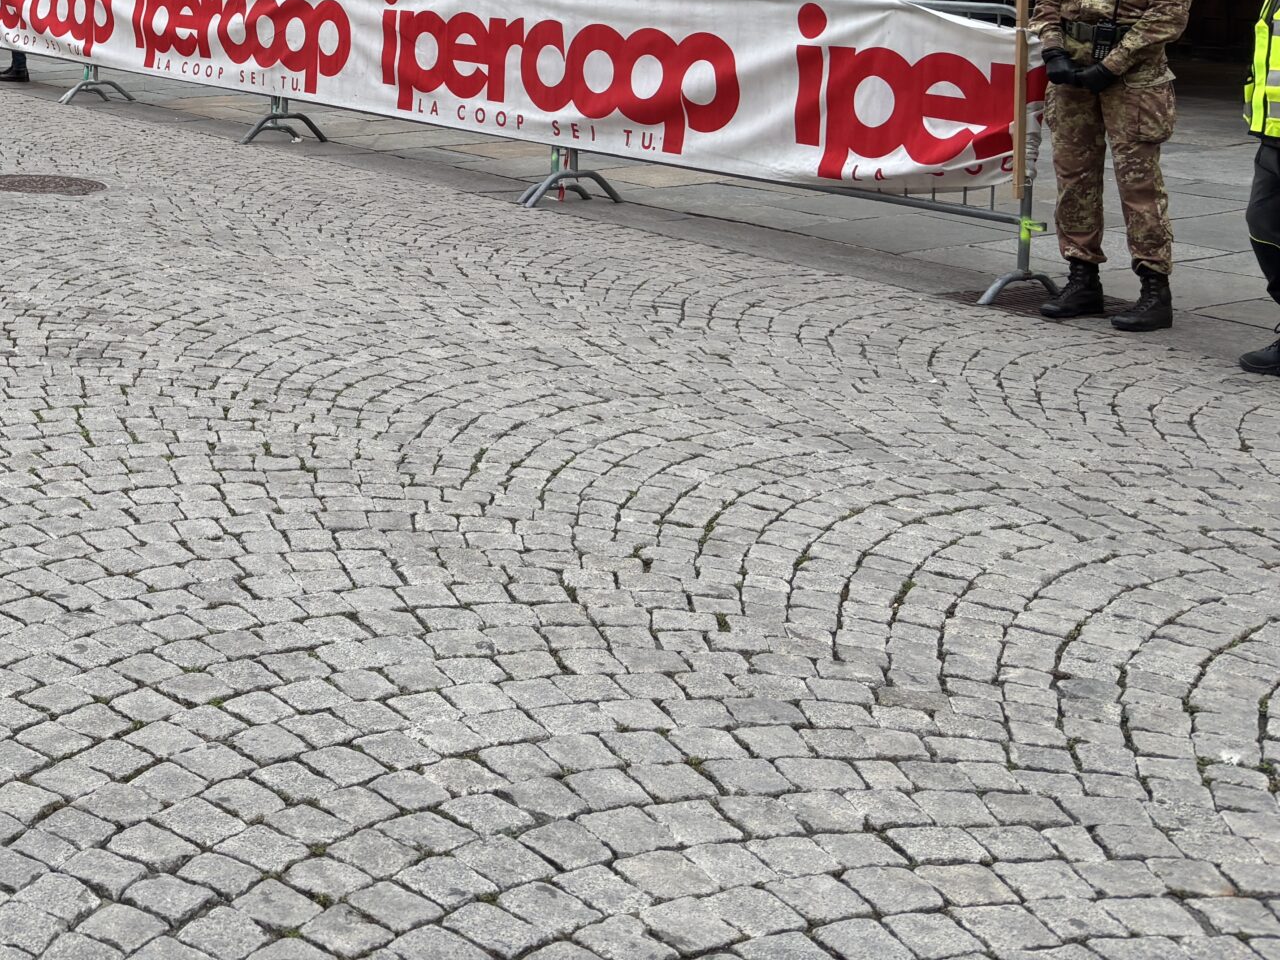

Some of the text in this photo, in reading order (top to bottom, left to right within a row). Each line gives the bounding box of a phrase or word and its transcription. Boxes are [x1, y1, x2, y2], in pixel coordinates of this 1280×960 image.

[4, 32, 36, 46] COOP
[46, 38, 61, 51] SEI
[157, 58, 301, 92] LA COOP SEI TU.
[418, 98, 656, 151] LA COOP SEI TU.
